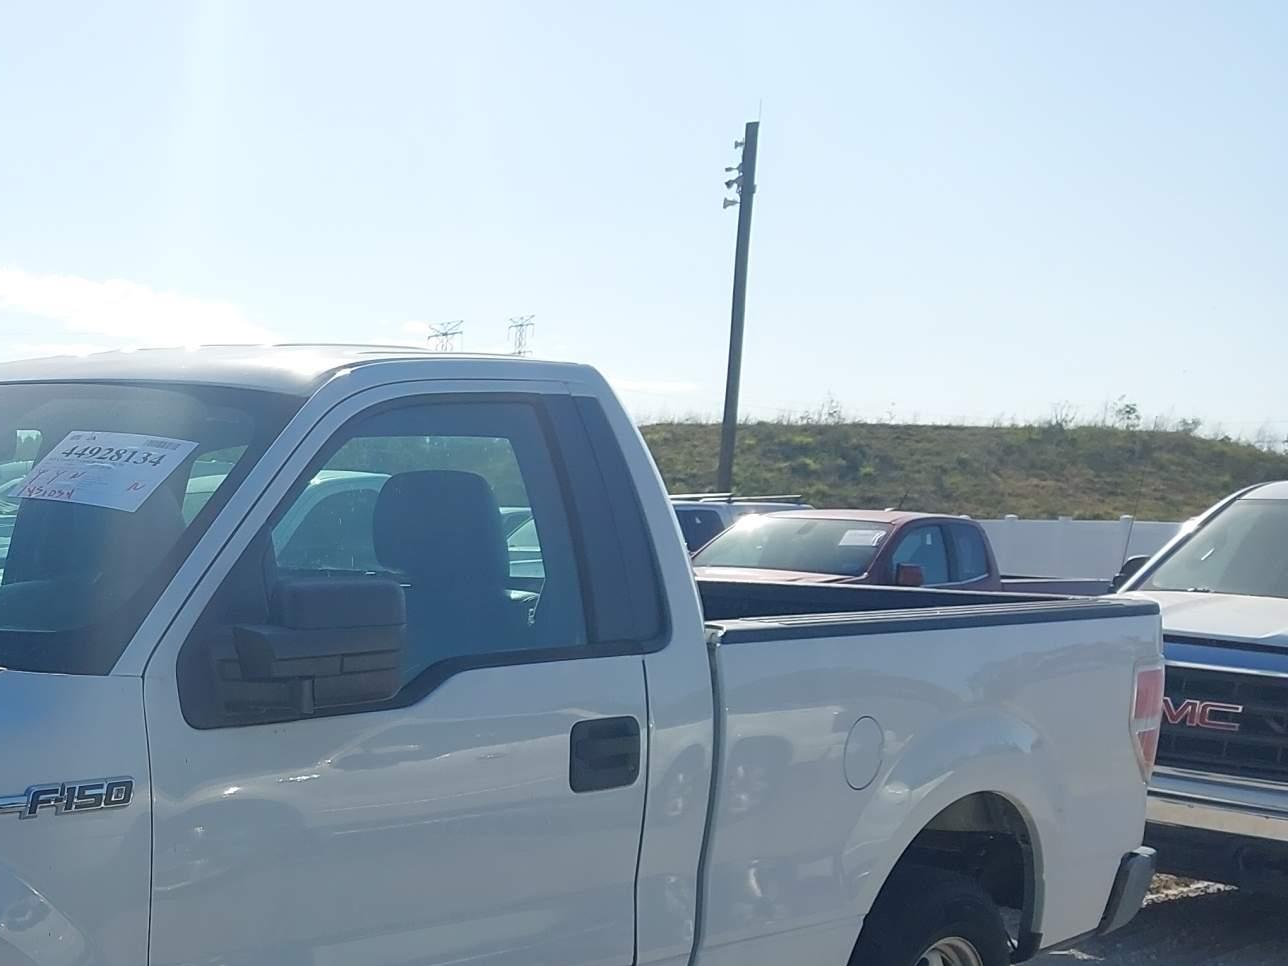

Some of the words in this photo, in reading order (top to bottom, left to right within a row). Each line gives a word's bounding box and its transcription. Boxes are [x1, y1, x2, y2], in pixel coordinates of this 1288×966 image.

[62, 445, 167, 467] 44928134
[1162, 697, 1243, 732] MC
[26, 779, 133, 816] F-150
